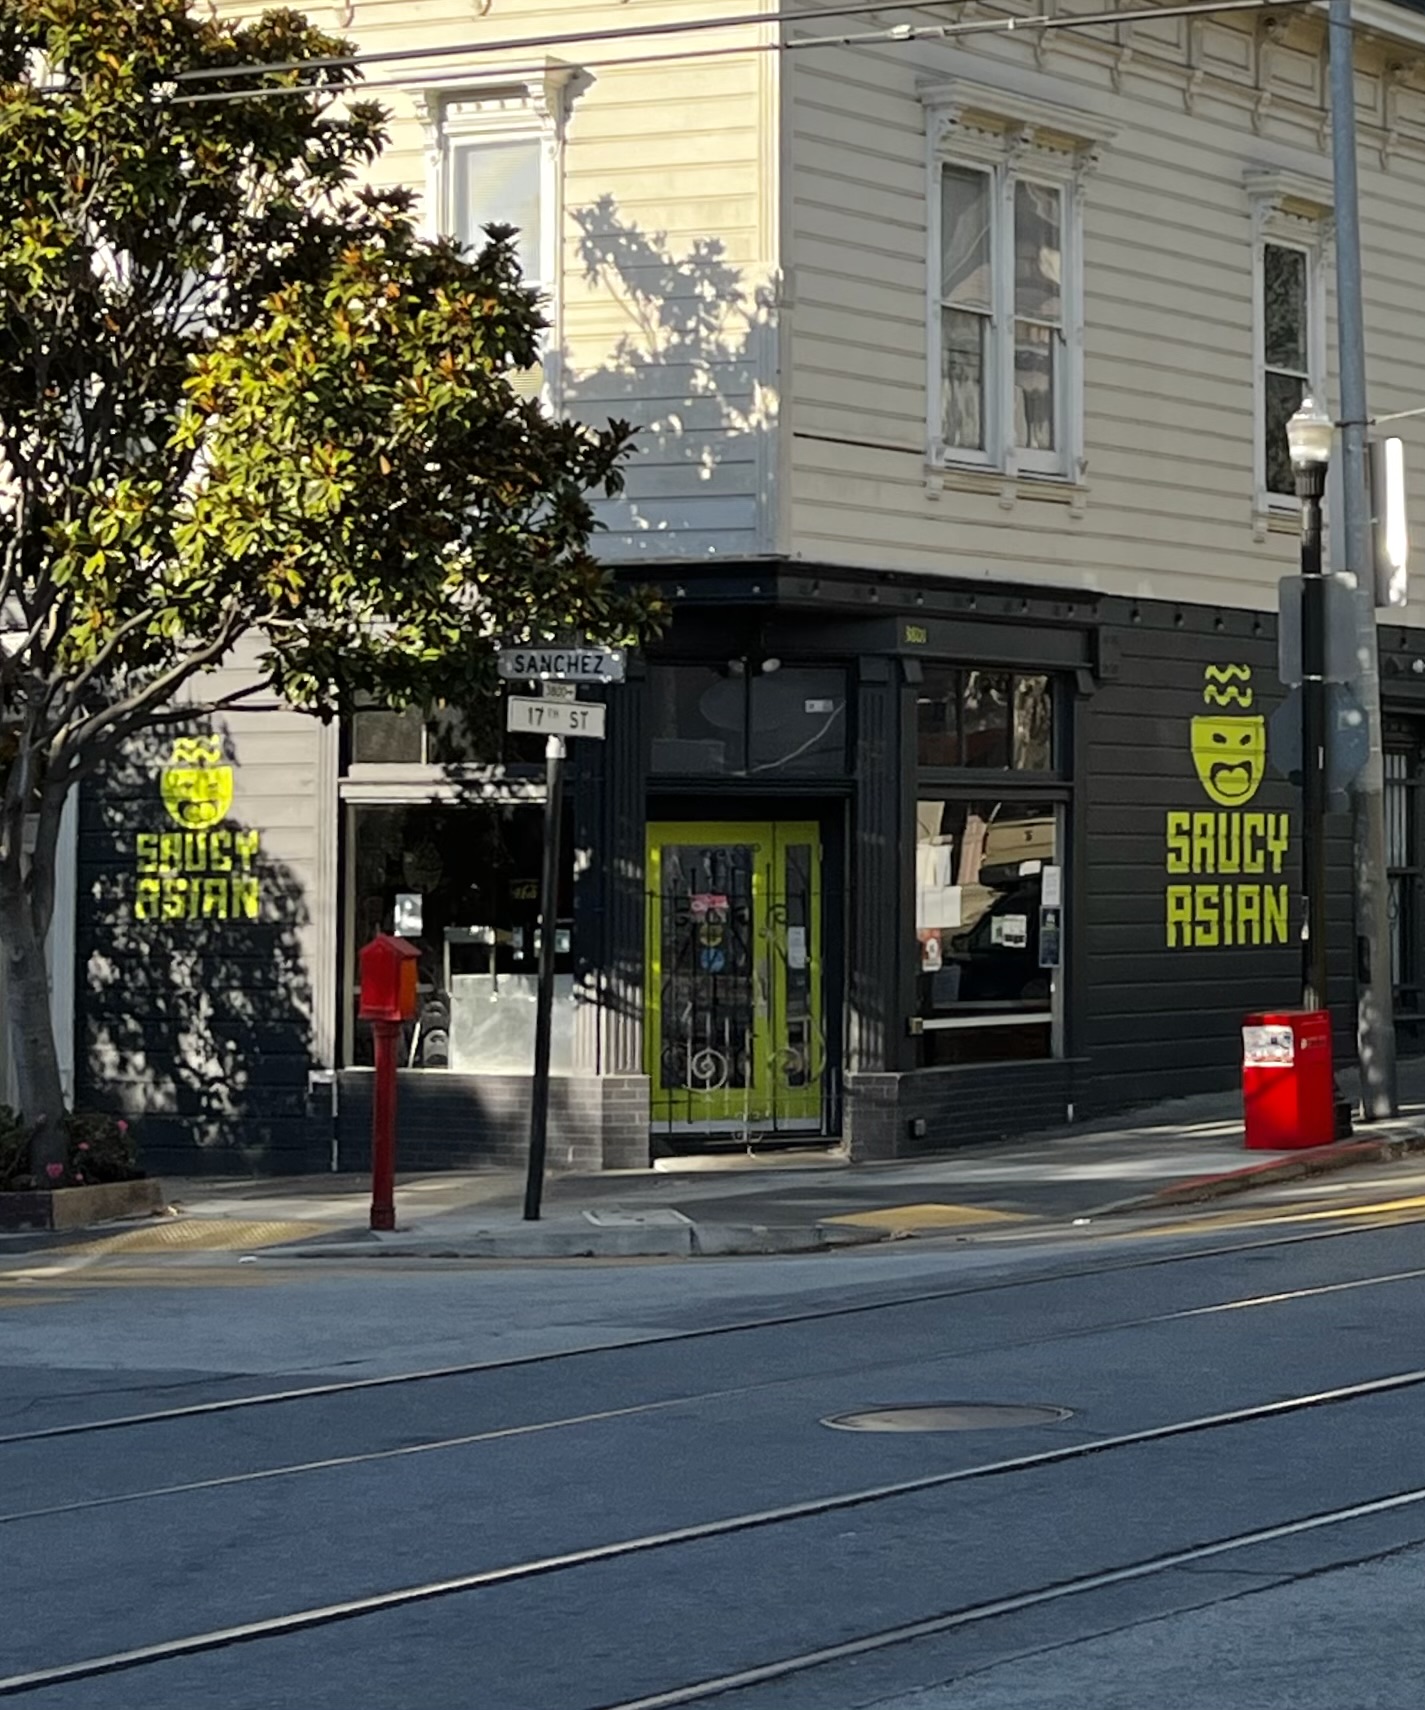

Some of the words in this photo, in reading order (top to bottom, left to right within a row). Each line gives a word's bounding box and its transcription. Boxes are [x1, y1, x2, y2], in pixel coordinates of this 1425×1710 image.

[514, 654, 605, 674] SANCHEZ
[569, 711, 589, 730] ST
[136, 831, 258, 873] SAUCY
[1167, 811, 1289, 873] SAUCY
[135, 877, 259, 919] ASIAN
[1167, 884, 1288, 947] ASIAN
